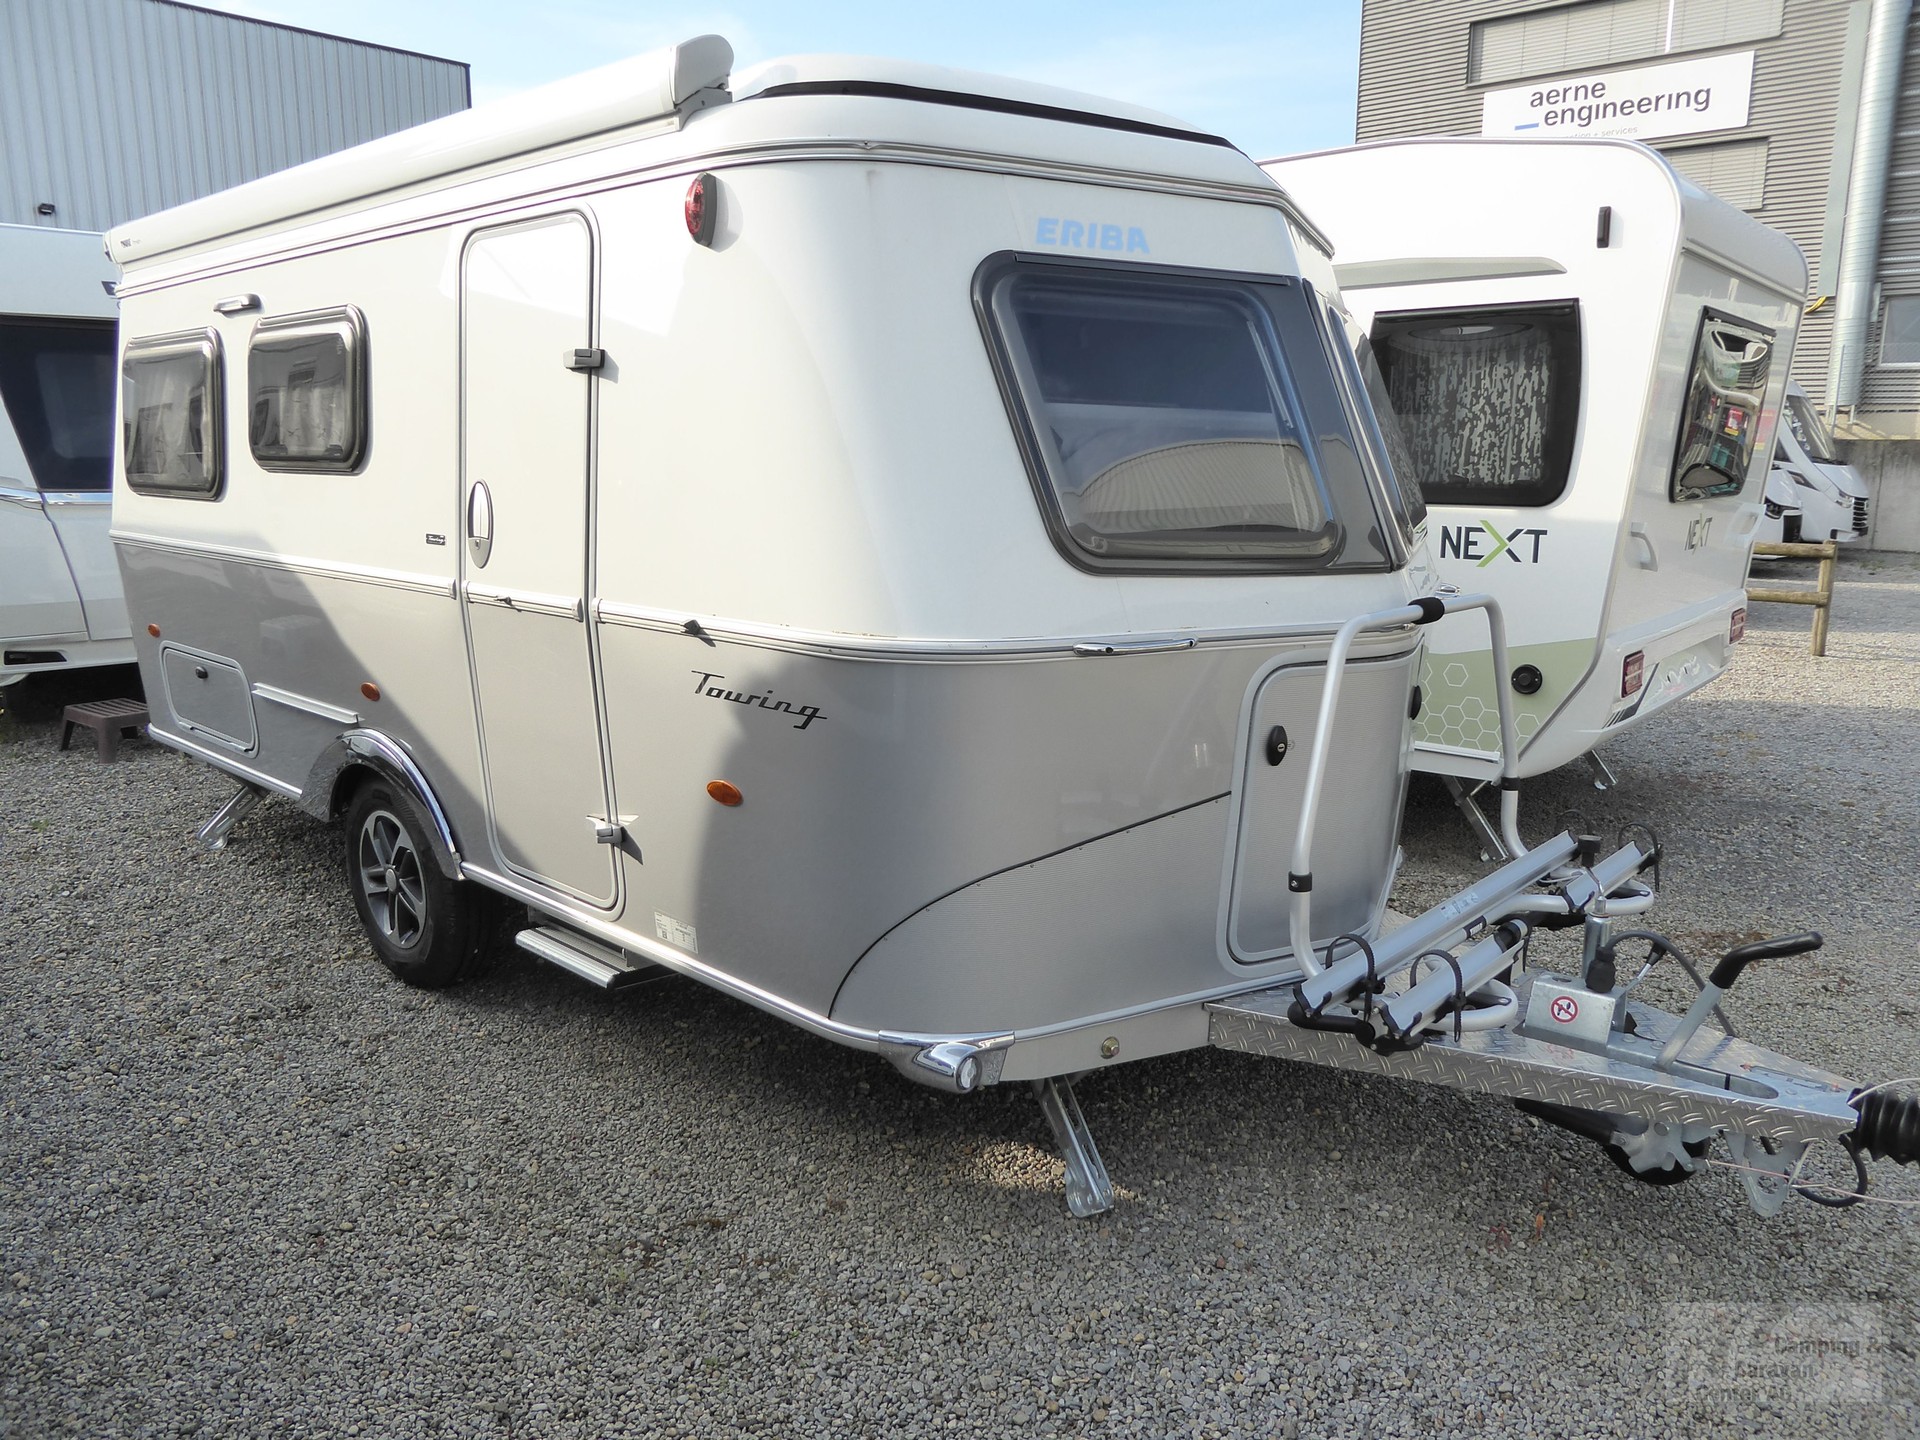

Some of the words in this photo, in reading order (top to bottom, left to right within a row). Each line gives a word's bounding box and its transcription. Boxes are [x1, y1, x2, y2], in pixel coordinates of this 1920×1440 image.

[1530, 82, 1606, 108] aerne
[1544, 87, 1712, 128] engineering
[1601, 126, 1638, 137] services
[1036, 217, 1150, 254] ERIBA
[1440, 520, 1548, 567] NEXT
[691, 670, 828, 730] Touring
